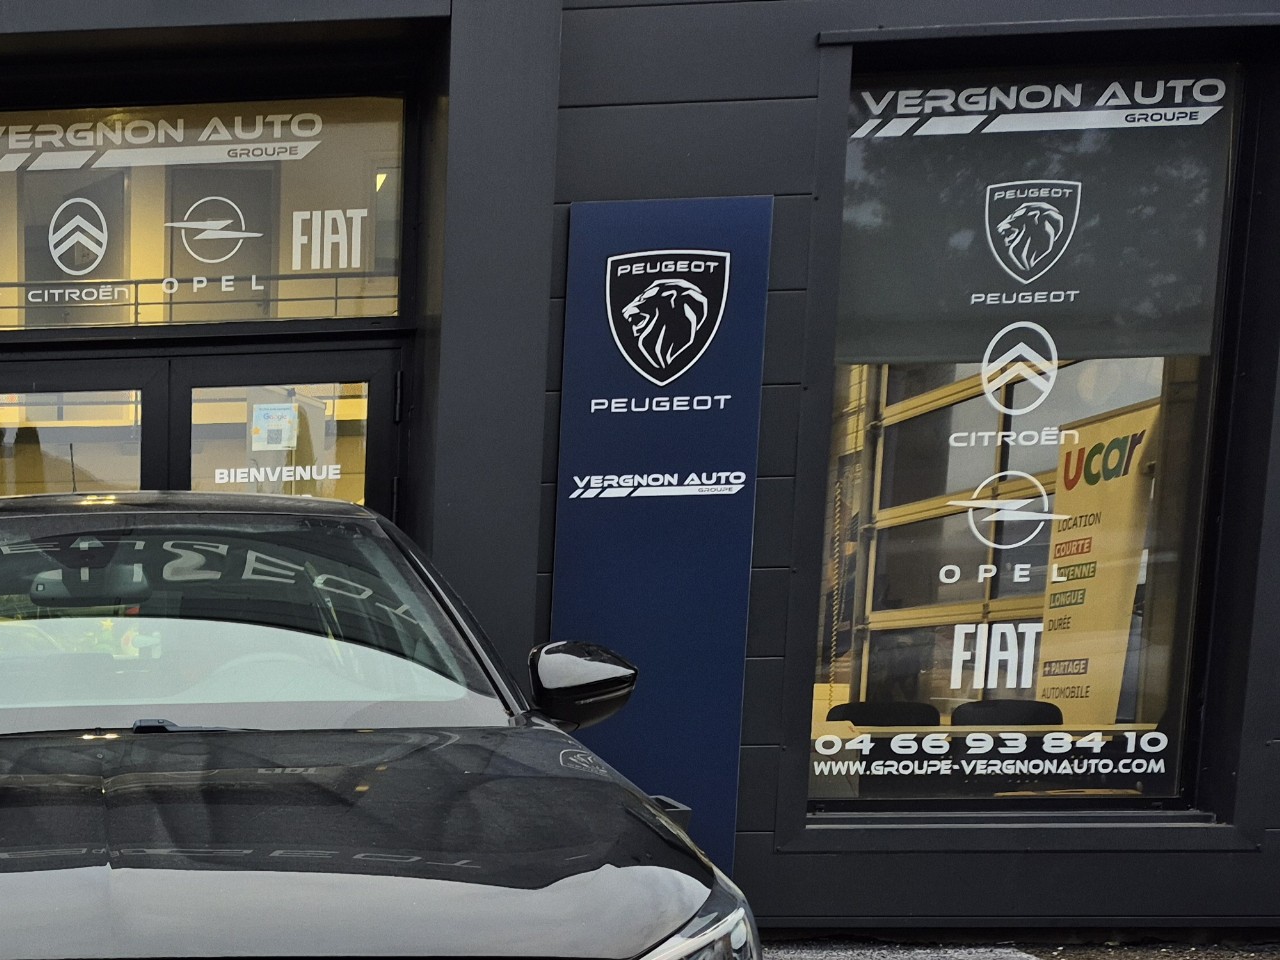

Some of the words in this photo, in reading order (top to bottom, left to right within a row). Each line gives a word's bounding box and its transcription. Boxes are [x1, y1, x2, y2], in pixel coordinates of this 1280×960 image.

[861, 83, 1083, 116] VERGNON
[1094, 78, 1226, 107] AUTO
[1124, 111, 1199, 123] GROUPE
[198, 113, 322, 142] AUTO
[227, 145, 299, 158] GROUPE
[994, 188, 1073, 201] PEUGEOT
[291, 208, 368, 271] FIAT
[617, 260, 719, 277] PEUGEOT
[162, 274, 264, 294] OPEL
[970, 290, 1080, 305] PEUGEOT
[590, 394, 732, 413] PEUGEOT
[214, 464, 341, 484] BIENVENUE
[573, 473, 678, 487] VERGNON
[683, 471, 746, 486] AUTO
[1057, 512, 1102, 533] LOCATION
[1055, 539, 1091, 557] COURTE
[939, 563, 1067, 584] OPEL
[1054, 563, 1096, 581] OYENNE
[1051, 590, 1084, 606] LONGUE
[1047, 616, 1071, 632] DURÉE
[950, 623, 1044, 689] FIAT
[1041, 686, 1090, 700] AUTOMOBILE
[814, 734, 875, 755] 04
[890, 733, 950, 755] 66
[965, 733, 1028, 754] 93
[1042, 732, 1107, 754] 84
[1125, 731, 1168, 753] 10
[813, 759, 1165, 775] WWW.GROUPE-VERGNONAUTO.COM
